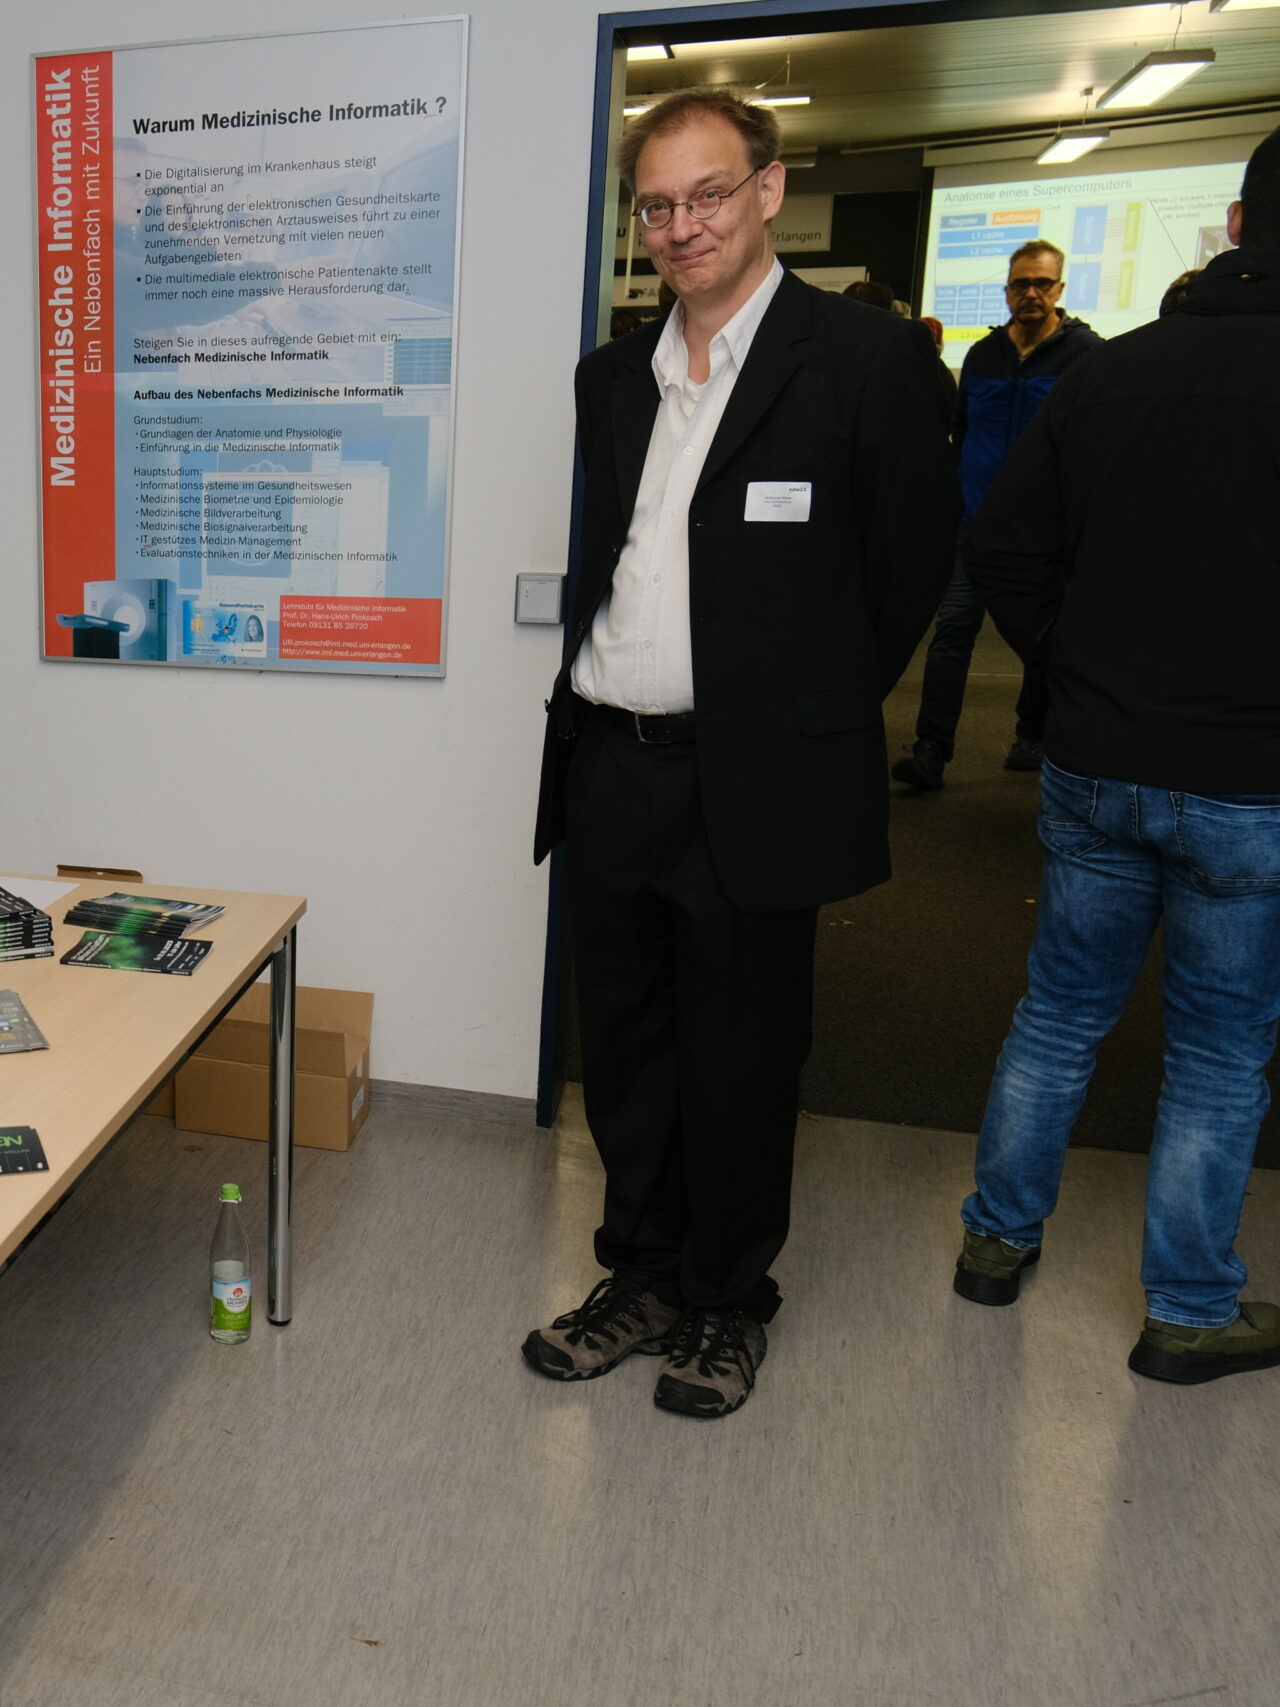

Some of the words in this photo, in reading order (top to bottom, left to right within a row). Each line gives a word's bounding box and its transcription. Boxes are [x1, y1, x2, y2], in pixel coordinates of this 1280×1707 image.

[81, 65, 100, 155] Zukunft
[133, 118, 194, 134] Warum
[202, 107, 321, 130] Medizinische
[329, 98, 428, 121] Informatik
[435, 96, 447, 114] ?
[45, 68, 73, 251] Informatik
[144, 169, 162, 180] Die
[166, 164, 244, 181] Digitalisierung
[247, 163, 261, 174] im
[265, 159, 340, 173] Krankenhaus
[344, 156, 377, 169] steigt
[82, 162, 100, 200] mit
[145, 183, 206, 197] exponential
[210, 183, 224, 192] an
[944, 189, 995, 203] Anatomie
[999, 186, 1029, 198] eines
[1033, 178, 1132, 197] Supercomputers
[145, 206, 162, 217] Die
[166, 203, 224, 216] Einführung
[227, 202, 245, 212] der
[248, 197, 332, 211] elektronischen
[336, 192, 440, 207] Gesundheitskarte
[145, 222, 164, 233] und
[168, 220, 188, 231] des
[191, 216, 272, 230] elektronischen
[276, 212, 358, 226] Arztausweises
[362, 210, 389, 222] führt
[393, 211, 406, 221] zu
[410, 209, 440, 220] einer
[145, 236, 220, 249] zunehmenden
[223, 233, 285, 245] Vernetzung
[289, 231, 307, 242] mit
[310, 230, 344, 241] vielen
[348, 229, 384, 240] neuen
[771, 231, 822, 244] Erlangen
[145, 251, 241, 267] Aufgabengebieten
[83, 209, 101, 331] Nebenfach
[145, 274, 162, 284] Die
[166, 271, 235, 283] multimediale
[239, 268, 314, 281] elektronische
[318, 265, 398, 278] Patientenakte
[403, 263, 432, 275] stellt
[145, 290, 178, 301] immer
[182, 287, 208, 299] noch
[211, 287, 234, 297] eine
[238, 285, 284, 297] massive
[288, 283, 384, 296] Herausforderung
[134, 338, 173, 350] Steigen
[177, 337, 194, 347] Sie
[198, 336, 207, 346] in
[211, 335, 247, 346] dieses
[251, 334, 313, 347] aufregende
[317, 333, 354, 344] Gebiet
[358, 332, 376, 343] mit
[84, 340, 101, 373] Ein
[134, 353, 190, 364] Nebenfach
[194, 351, 267, 363] Medizinische
[271, 350, 329, 361] Informatik
[48, 265, 75, 486] Medizinische
[134, 390, 170, 400] Aufbau
[174, 389, 193, 399] des
[197, 388, 261, 399] Nebenfachs
[266, 387, 340, 398] Medizinische
[344, 386, 404, 397] Informatik
[134, 415, 203, 425] Grundstudium:
[140, 429, 193, 440] Grundlagen
[197, 428, 212, 438] der
[215, 428, 261, 438] Anatomie
[264, 428, 283, 437] und
[286, 427, 342, 439] Physiologie
[140, 442, 190, 454] Einführung
[193, 443, 202, 452] in
[204, 443, 219, 452] die
[223, 442, 286, 452] Medizinische
[289, 442, 339, 452] Informatik
[134, 467, 202, 478] Hauptstudium:
[140, 481, 239, 491] Informationssysteme
[242, 481, 254, 490] im
[257, 481, 352, 491] Gesundheitswesen
[140, 494, 200, 504] Medizinische
[204, 495, 250, 504] Biometrie
[253, 496, 271, 505] und
[274, 496, 344, 507] Epidemiologie
[140, 508, 200, 517] Medizinische
[204, 508, 282, 520] Bildverarbeitung
[140, 521, 200, 531] Medizinische
[204, 522, 308, 534] Biosignalverarbeitung
[140, 535, 149, 544] IT
[199, 536, 302, 548] Medizin-Management
[140, 548, 239, 559] Evaluationstechniken
[243, 549, 251, 559] in
[254, 550, 270, 560] der
[273, 551, 343, 561] Medizinischen
[347, 552, 398, 562] Informatik
[315, 603, 325, 611] für
[327, 604, 370, 612] Medizinische
[372, 605, 406, 613] Informatik
